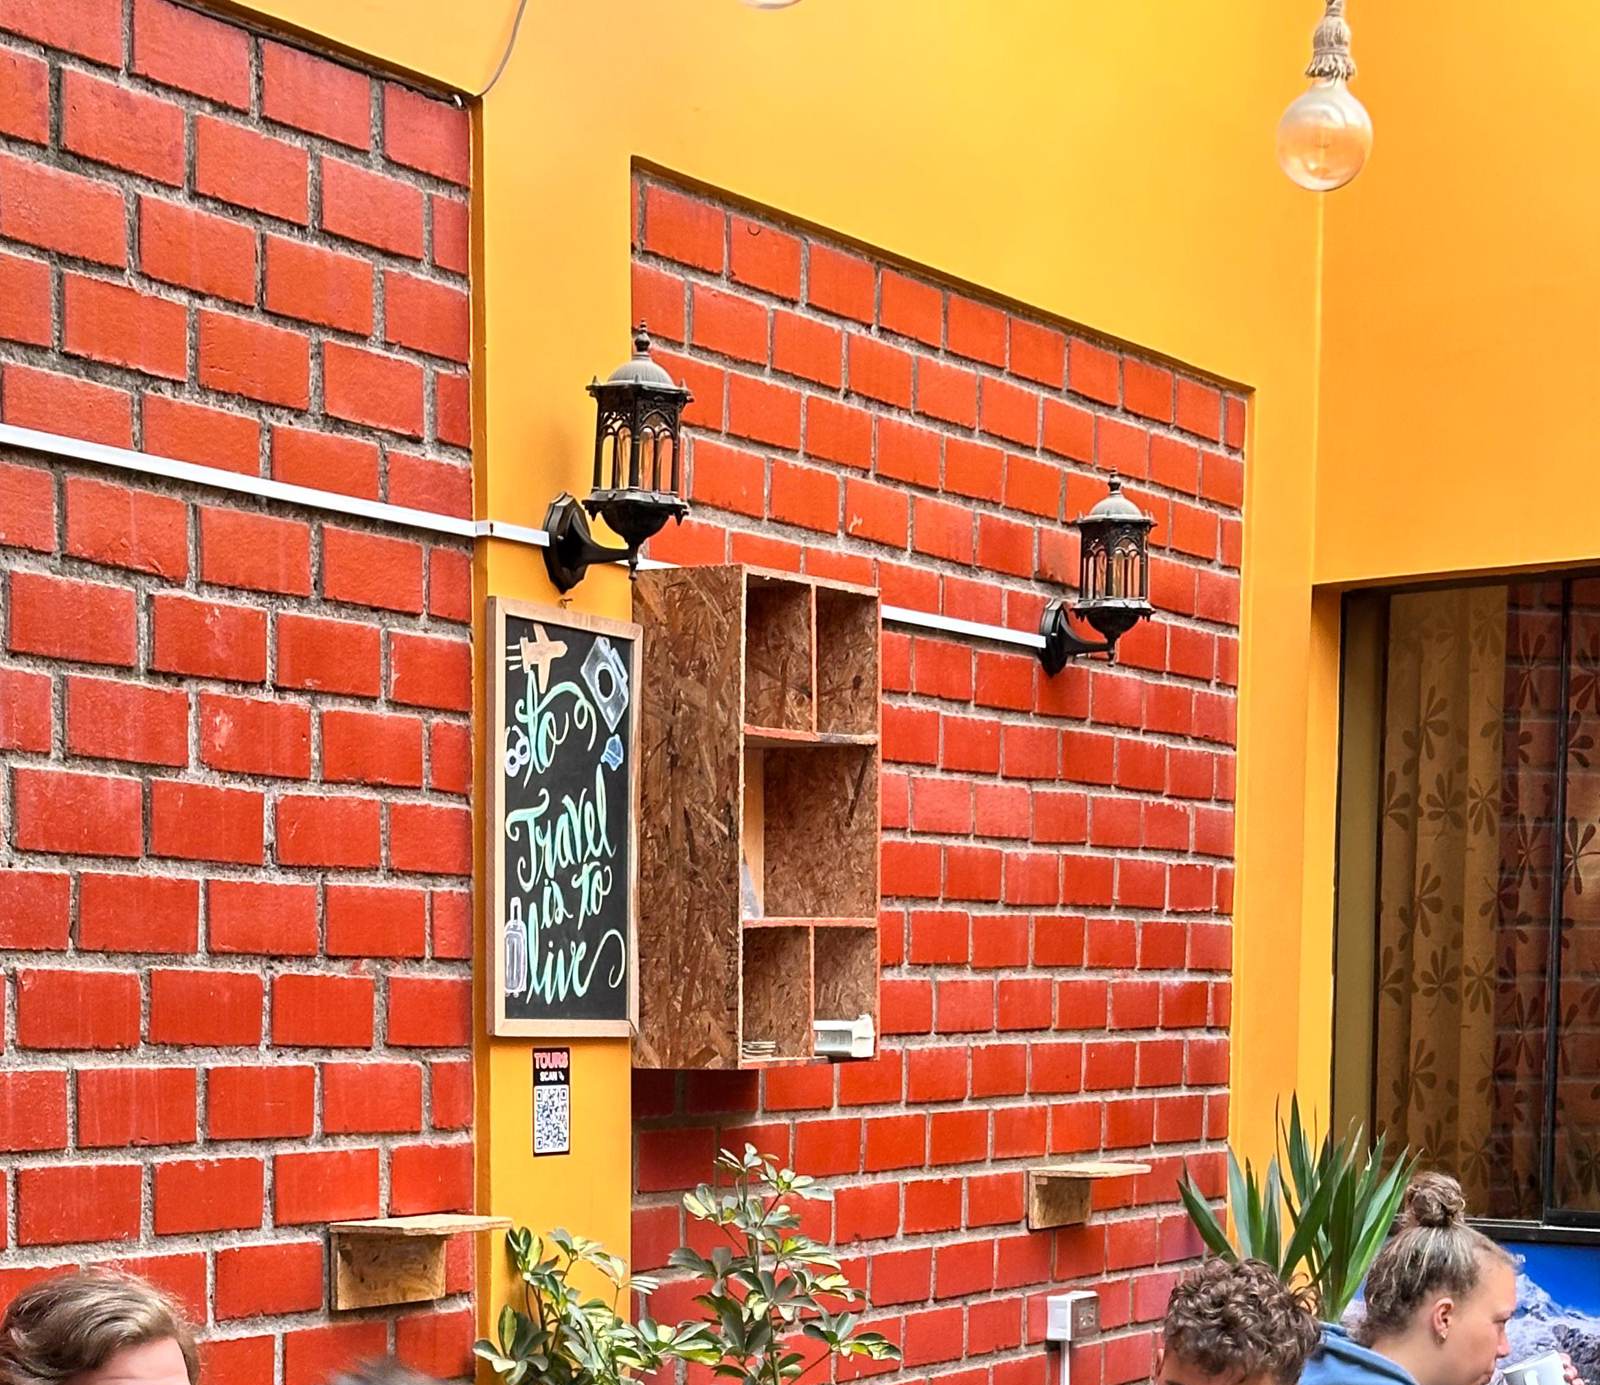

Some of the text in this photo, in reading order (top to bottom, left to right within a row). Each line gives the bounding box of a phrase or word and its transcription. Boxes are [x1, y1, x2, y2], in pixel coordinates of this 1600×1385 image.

[505, 763, 617, 892] Travel
[541, 878, 574, 930] is
[526, 902, 626, 1005] live
[534, 1051, 569, 1069] TOURS
[540, 1070, 558, 1081] SCAN
